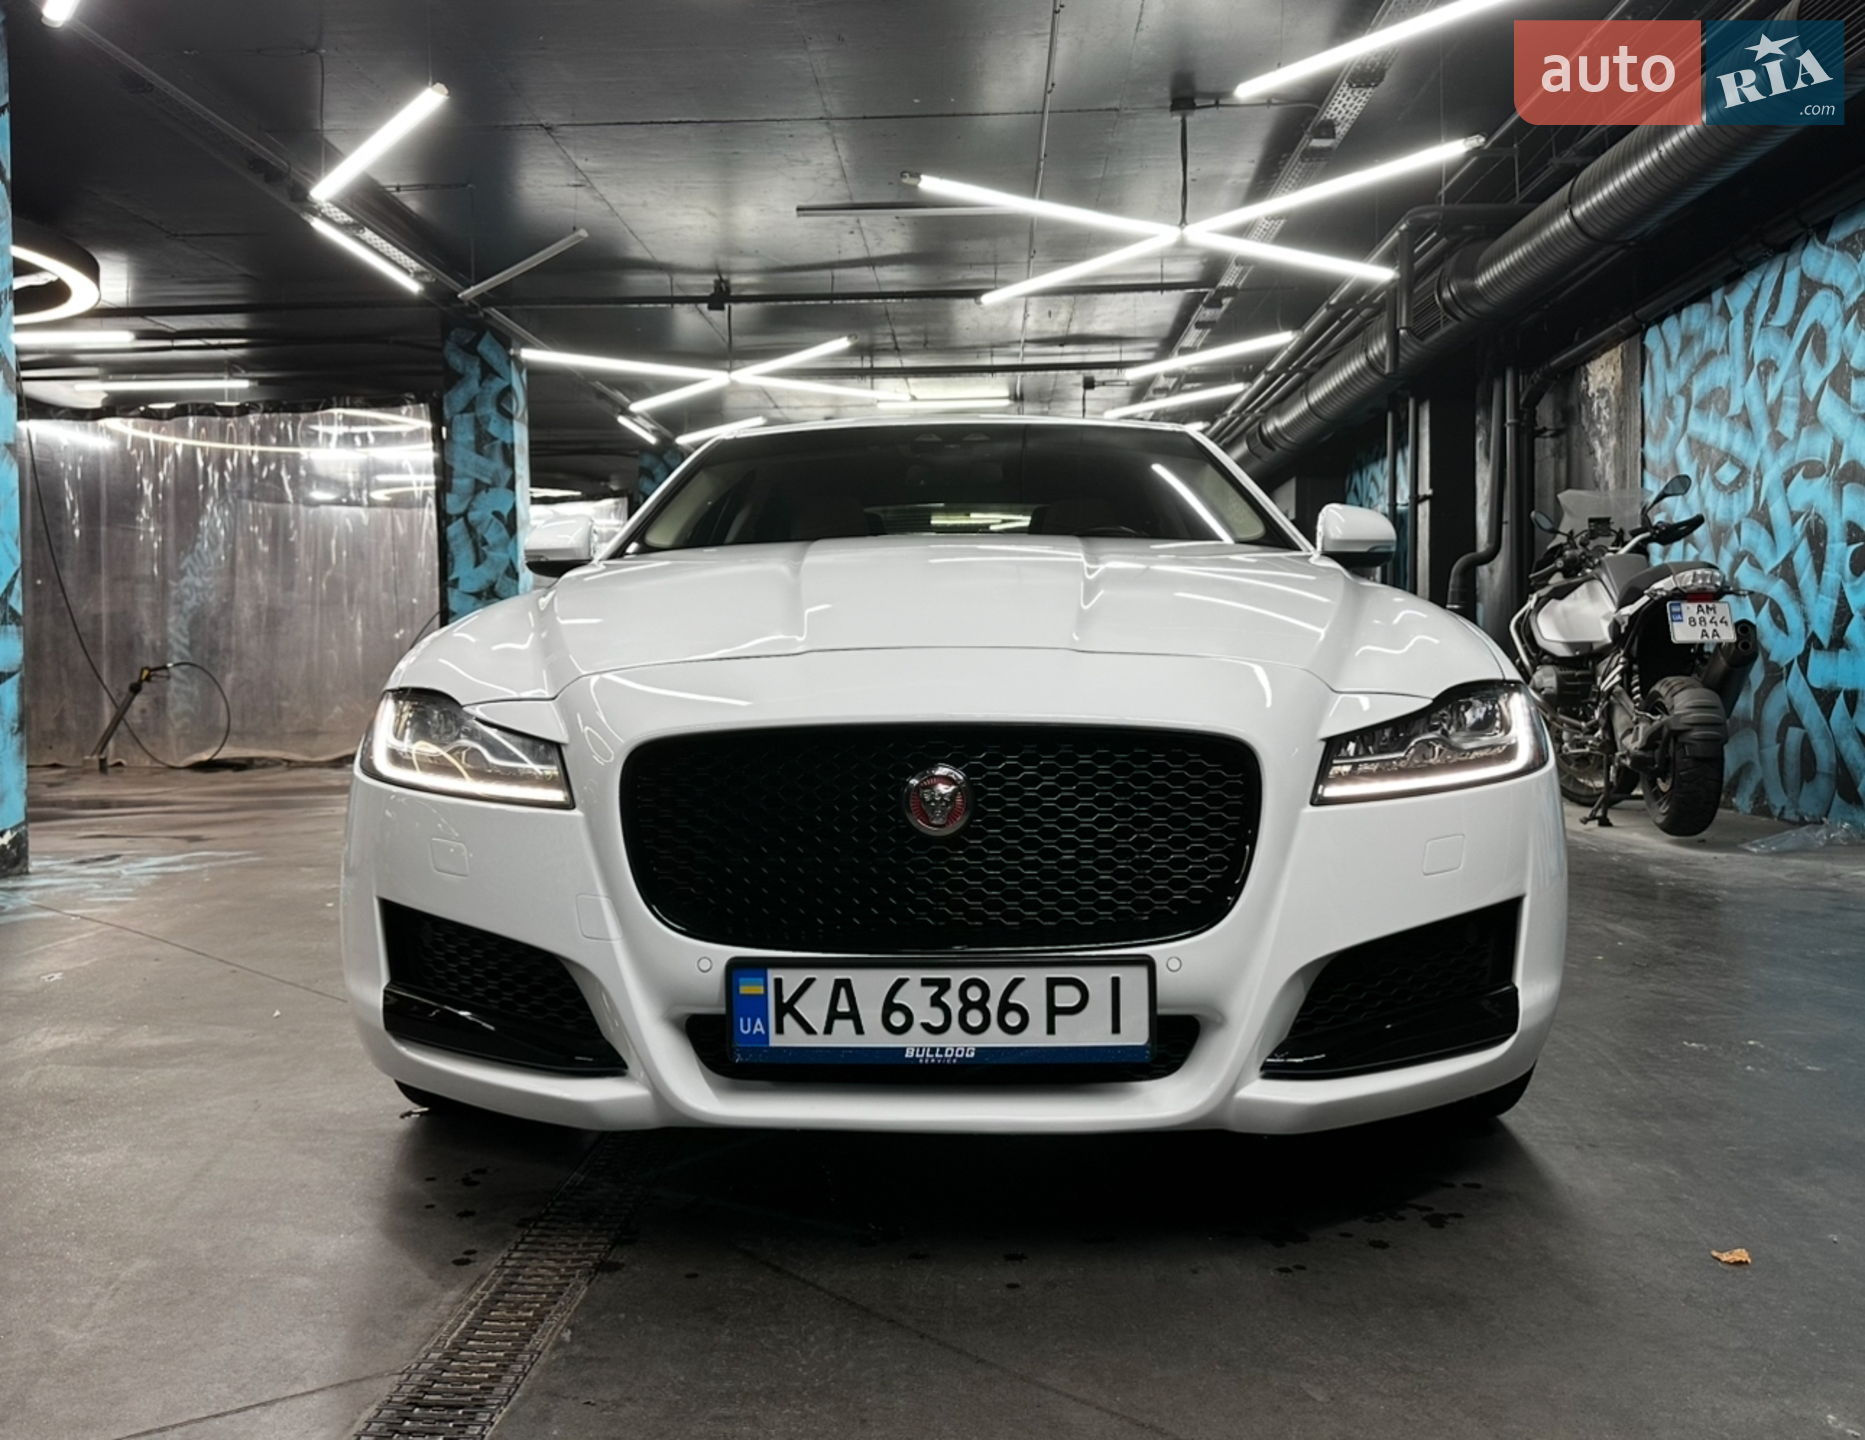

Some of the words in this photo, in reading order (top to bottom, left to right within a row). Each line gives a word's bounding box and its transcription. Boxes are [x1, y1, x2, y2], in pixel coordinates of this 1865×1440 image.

[1696, 604, 1717, 615] AM
[1688, 616, 1729, 627] 8844
[1701, 629, 1721, 639] AA
[773, 977, 865, 1035] KA
[881, 977, 1029, 1035] 6386
[740, 1017, 766, 1035] UA
[905, 1047, 976, 1058] BULLDOG
